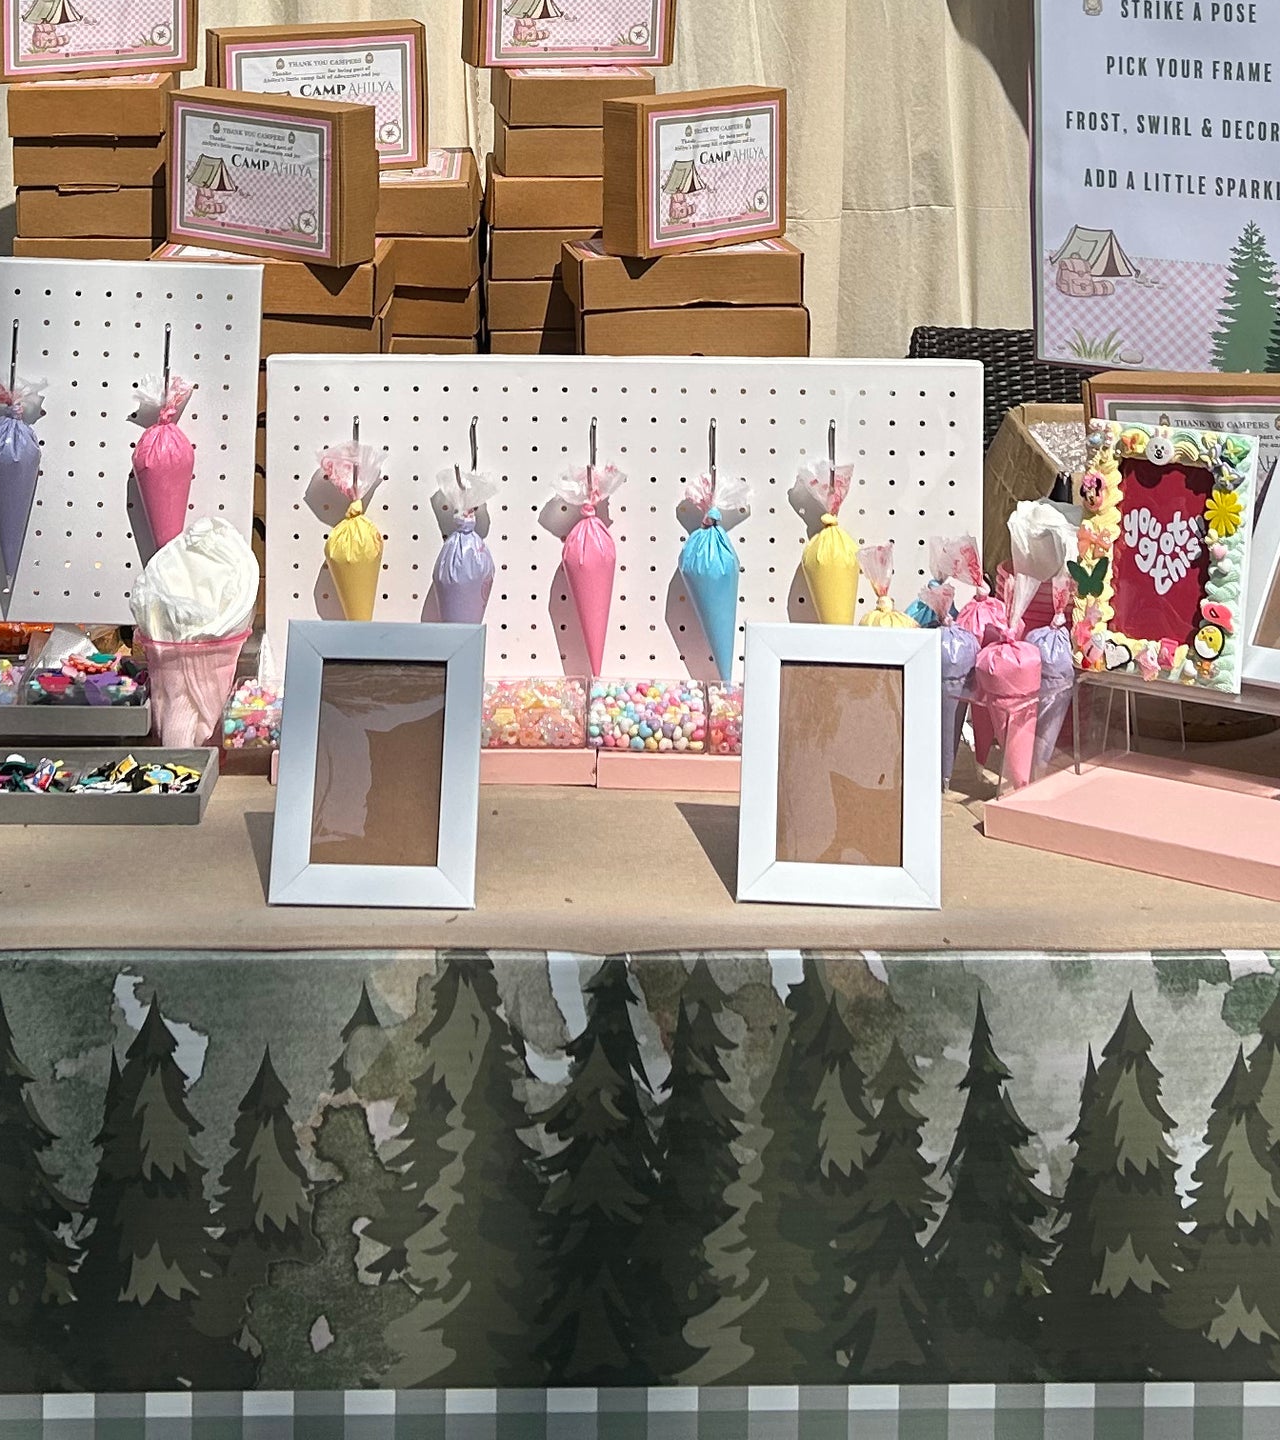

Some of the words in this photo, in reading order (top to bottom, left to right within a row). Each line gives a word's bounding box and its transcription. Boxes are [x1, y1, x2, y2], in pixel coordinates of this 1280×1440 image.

[1121, 0, 1184, 21] STRIKE
[1193, 2, 1202, 22] A
[1211, 3, 1257, 23] POSE
[1106, 56, 1147, 77] PICK
[1156, 58, 1203, 79] YOUR
[1212, 61, 1272, 83] FRAME
[300, 83, 346, 96] CAMP
[348, 81, 394, 97] AHILYA
[1066, 110, 1128, 135] FROST,
[1137, 115, 1192, 136] SWIRL
[1201, 118, 1213, 138] &
[231, 154, 270, 171] CAMP
[271, 161, 312, 178] AHILYA
[700, 151, 731, 164] CAMP
[1084, 168, 1117, 189] ADD
[1126, 171, 1135, 190] A
[1144, 172, 1206, 195] LITTLE
[1174, 419, 1205, 428] THANK
[1226, 421, 1270, 430] CAMPERS
[1124, 507, 1162, 547] you
[1135, 511, 1190, 573] got
